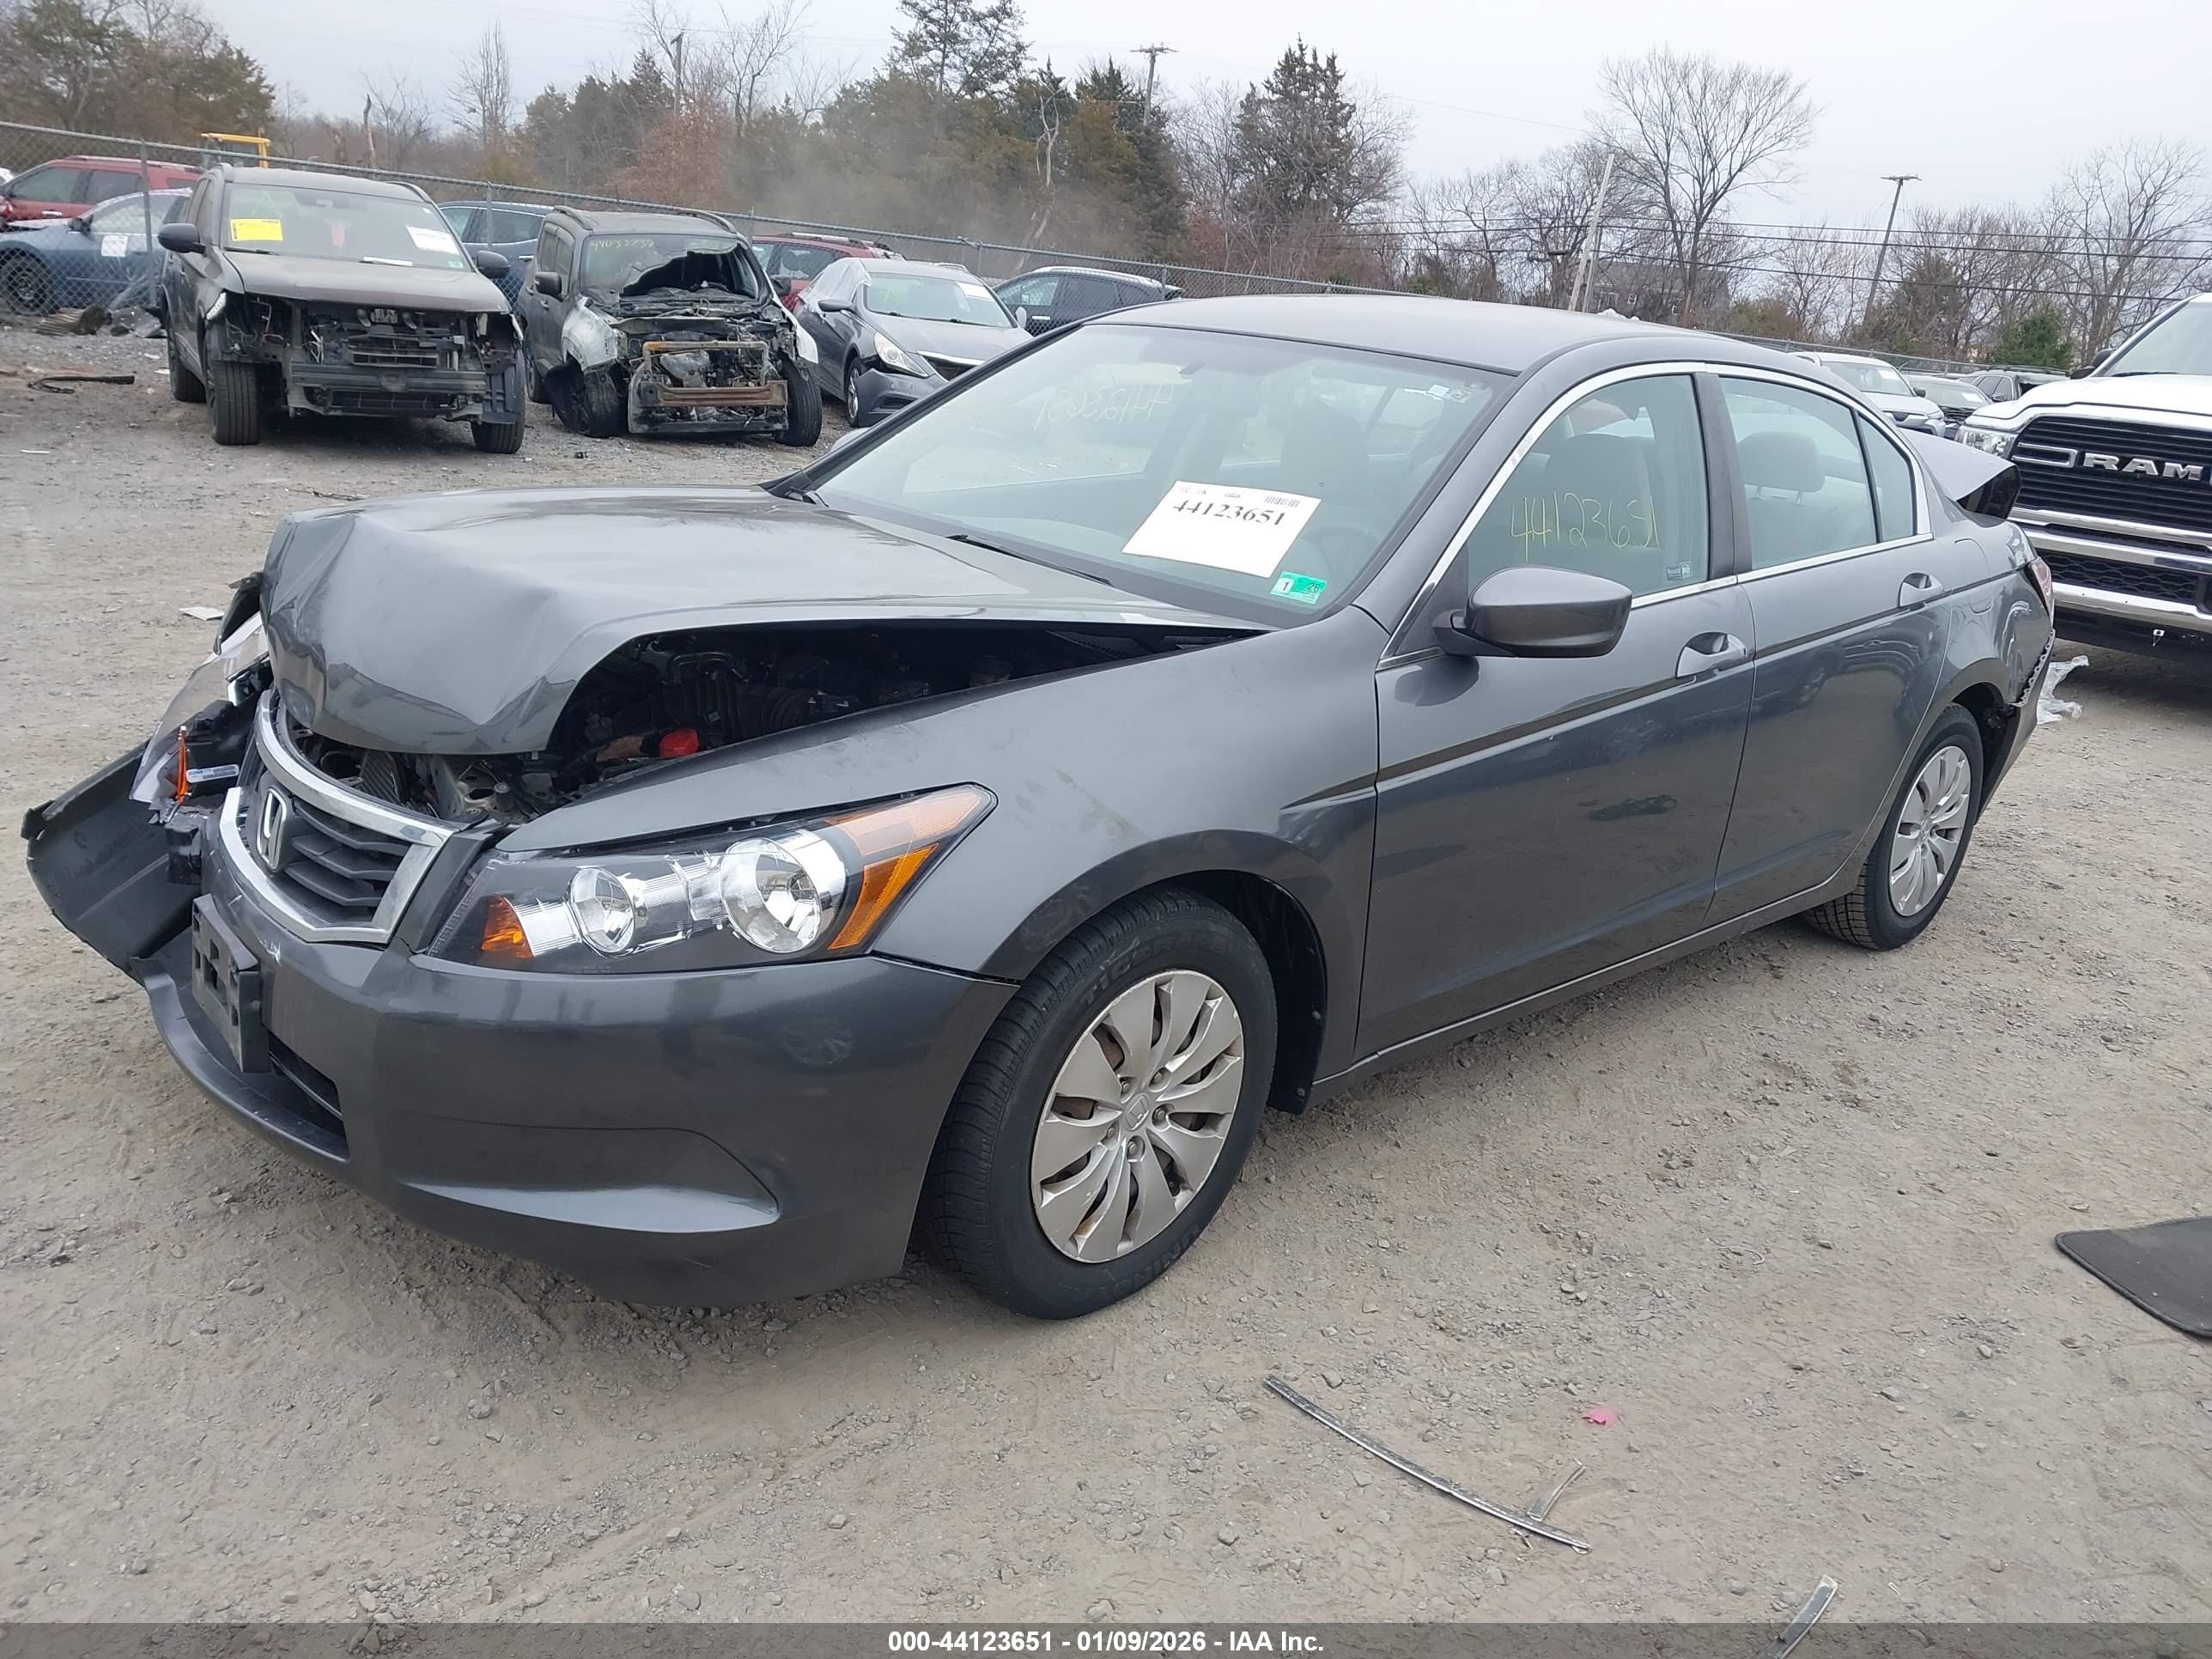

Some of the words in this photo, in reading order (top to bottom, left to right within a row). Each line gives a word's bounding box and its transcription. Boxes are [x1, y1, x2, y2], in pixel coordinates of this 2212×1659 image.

[2083, 453, 2203, 481] RAM
[1173, 500, 1285, 526] 44123651
[1511, 491, 1660, 563] 44123651
[1282, 581, 1290, 592] 1
